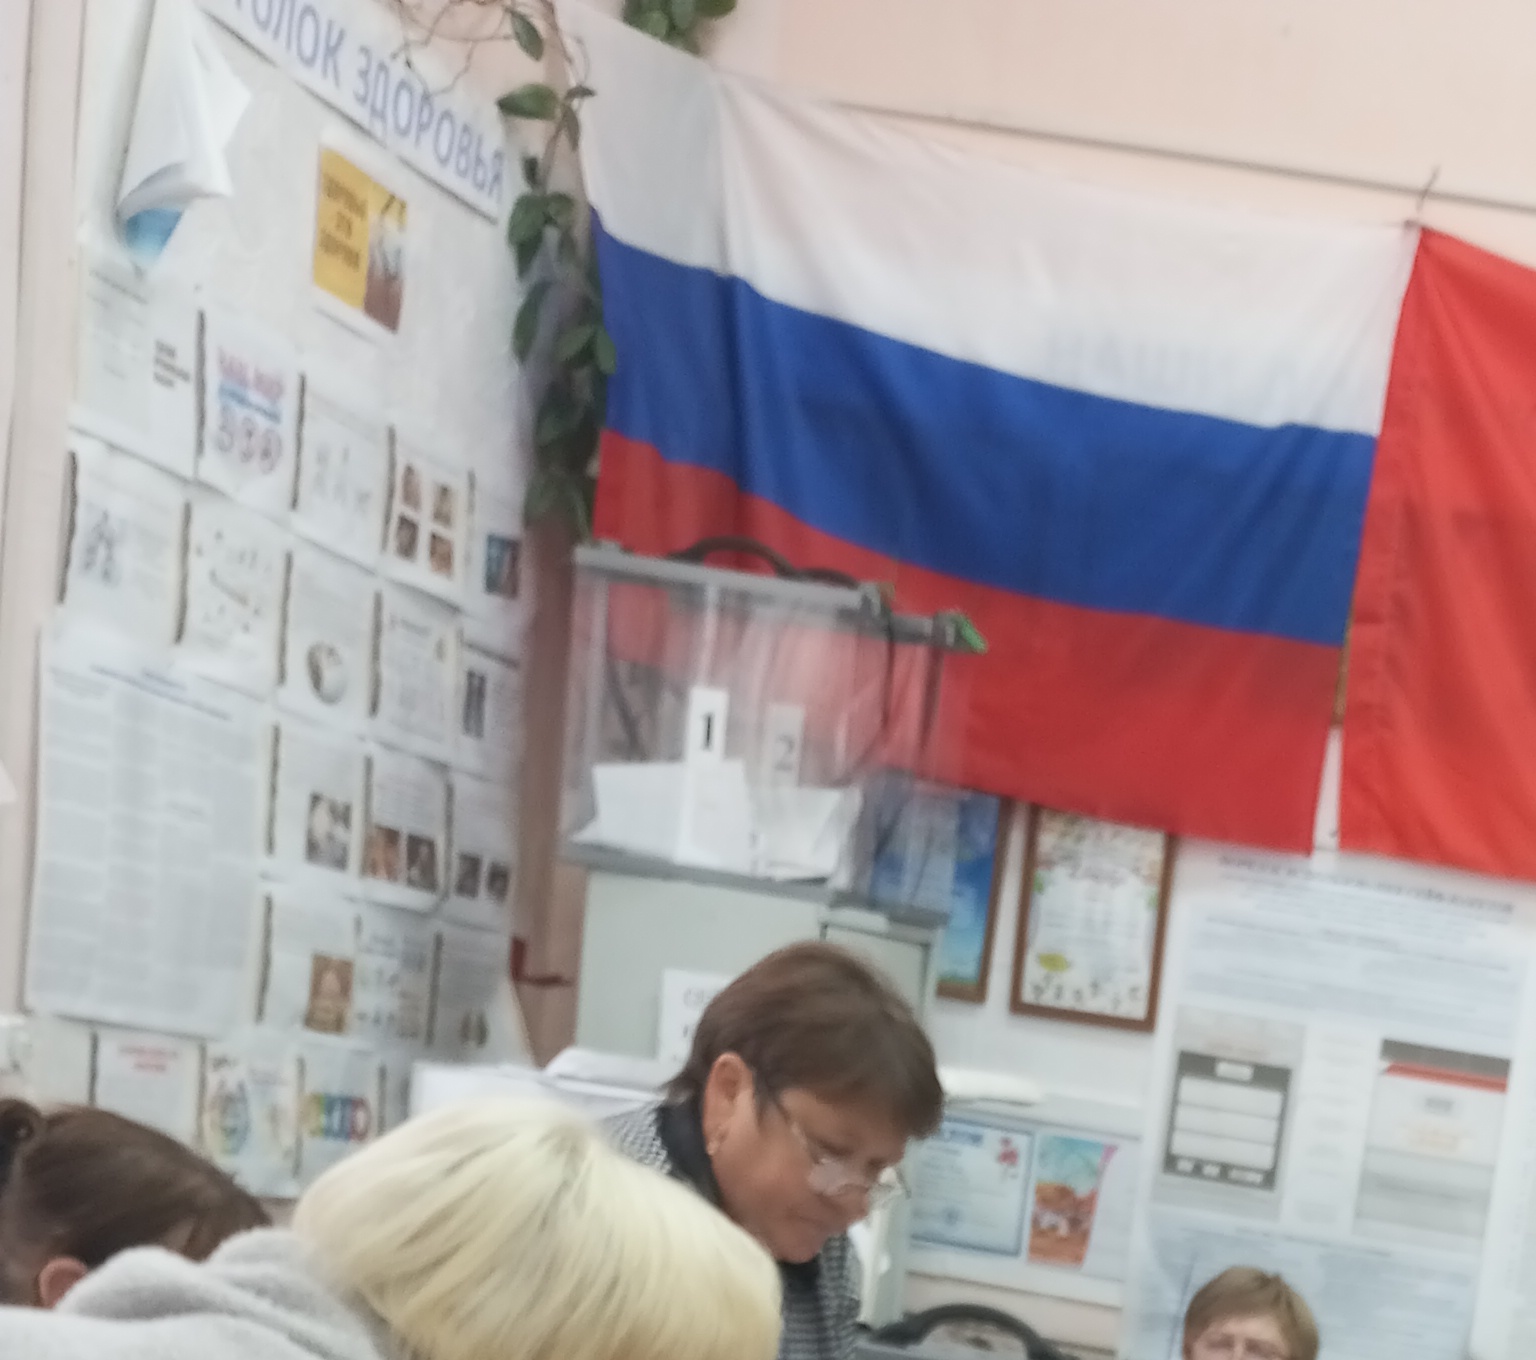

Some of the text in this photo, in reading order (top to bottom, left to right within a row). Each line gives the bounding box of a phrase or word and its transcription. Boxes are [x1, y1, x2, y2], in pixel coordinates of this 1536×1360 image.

[235, 0, 345, 88] ОЛОК
[352, 45, 505, 199] ЗДОРОВЬЯ
[701, 711, 716, 752] 1
[774, 732, 797, 772] 2
